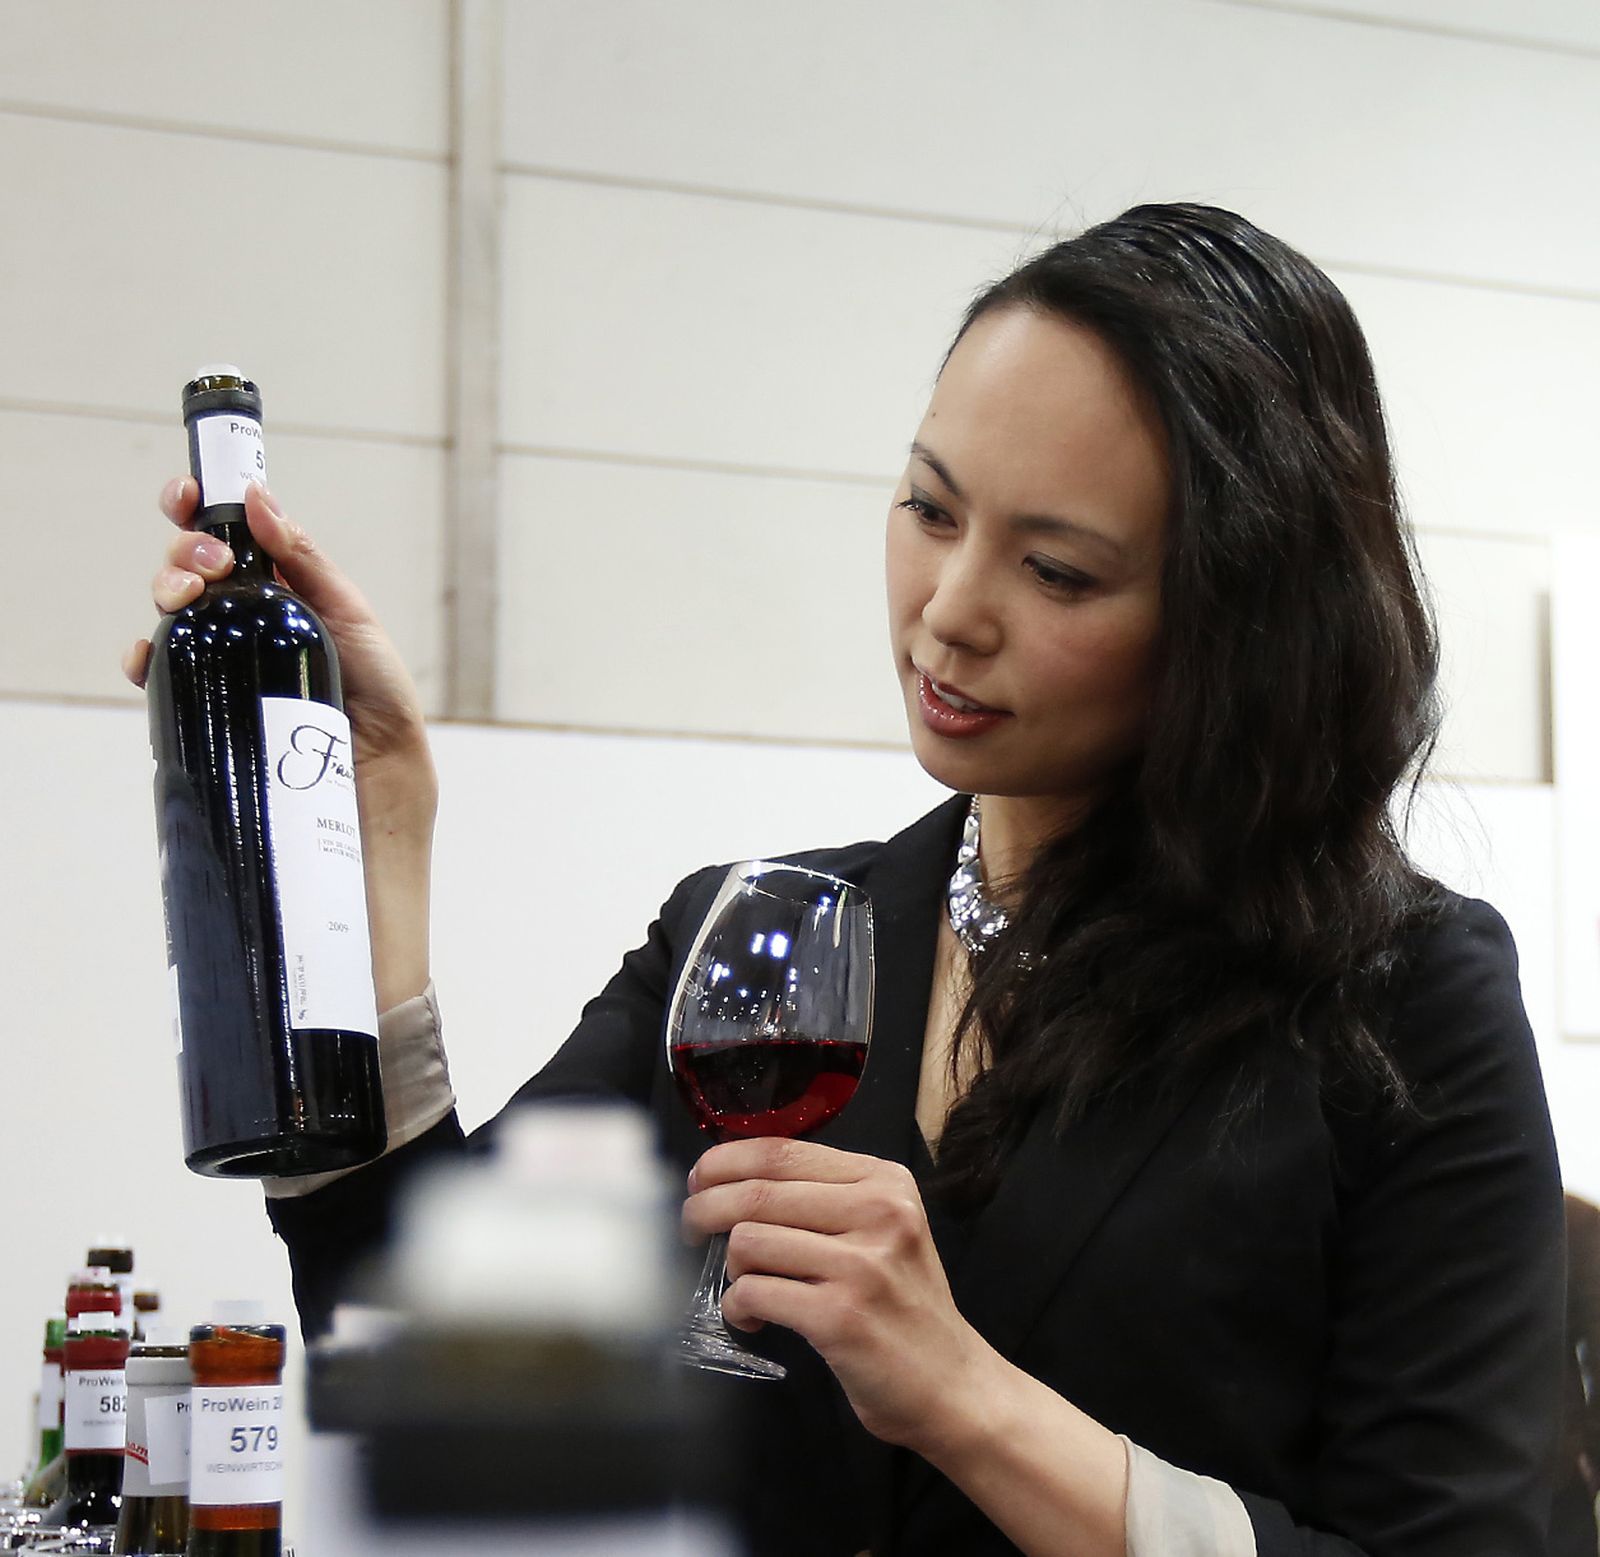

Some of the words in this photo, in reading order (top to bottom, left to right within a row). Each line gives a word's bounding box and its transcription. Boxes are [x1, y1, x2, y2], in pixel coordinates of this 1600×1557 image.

[328, 921, 349, 933] 2009
[202, 1397, 269, 1412] ProWein
[231, 1425, 278, 1453] 579
